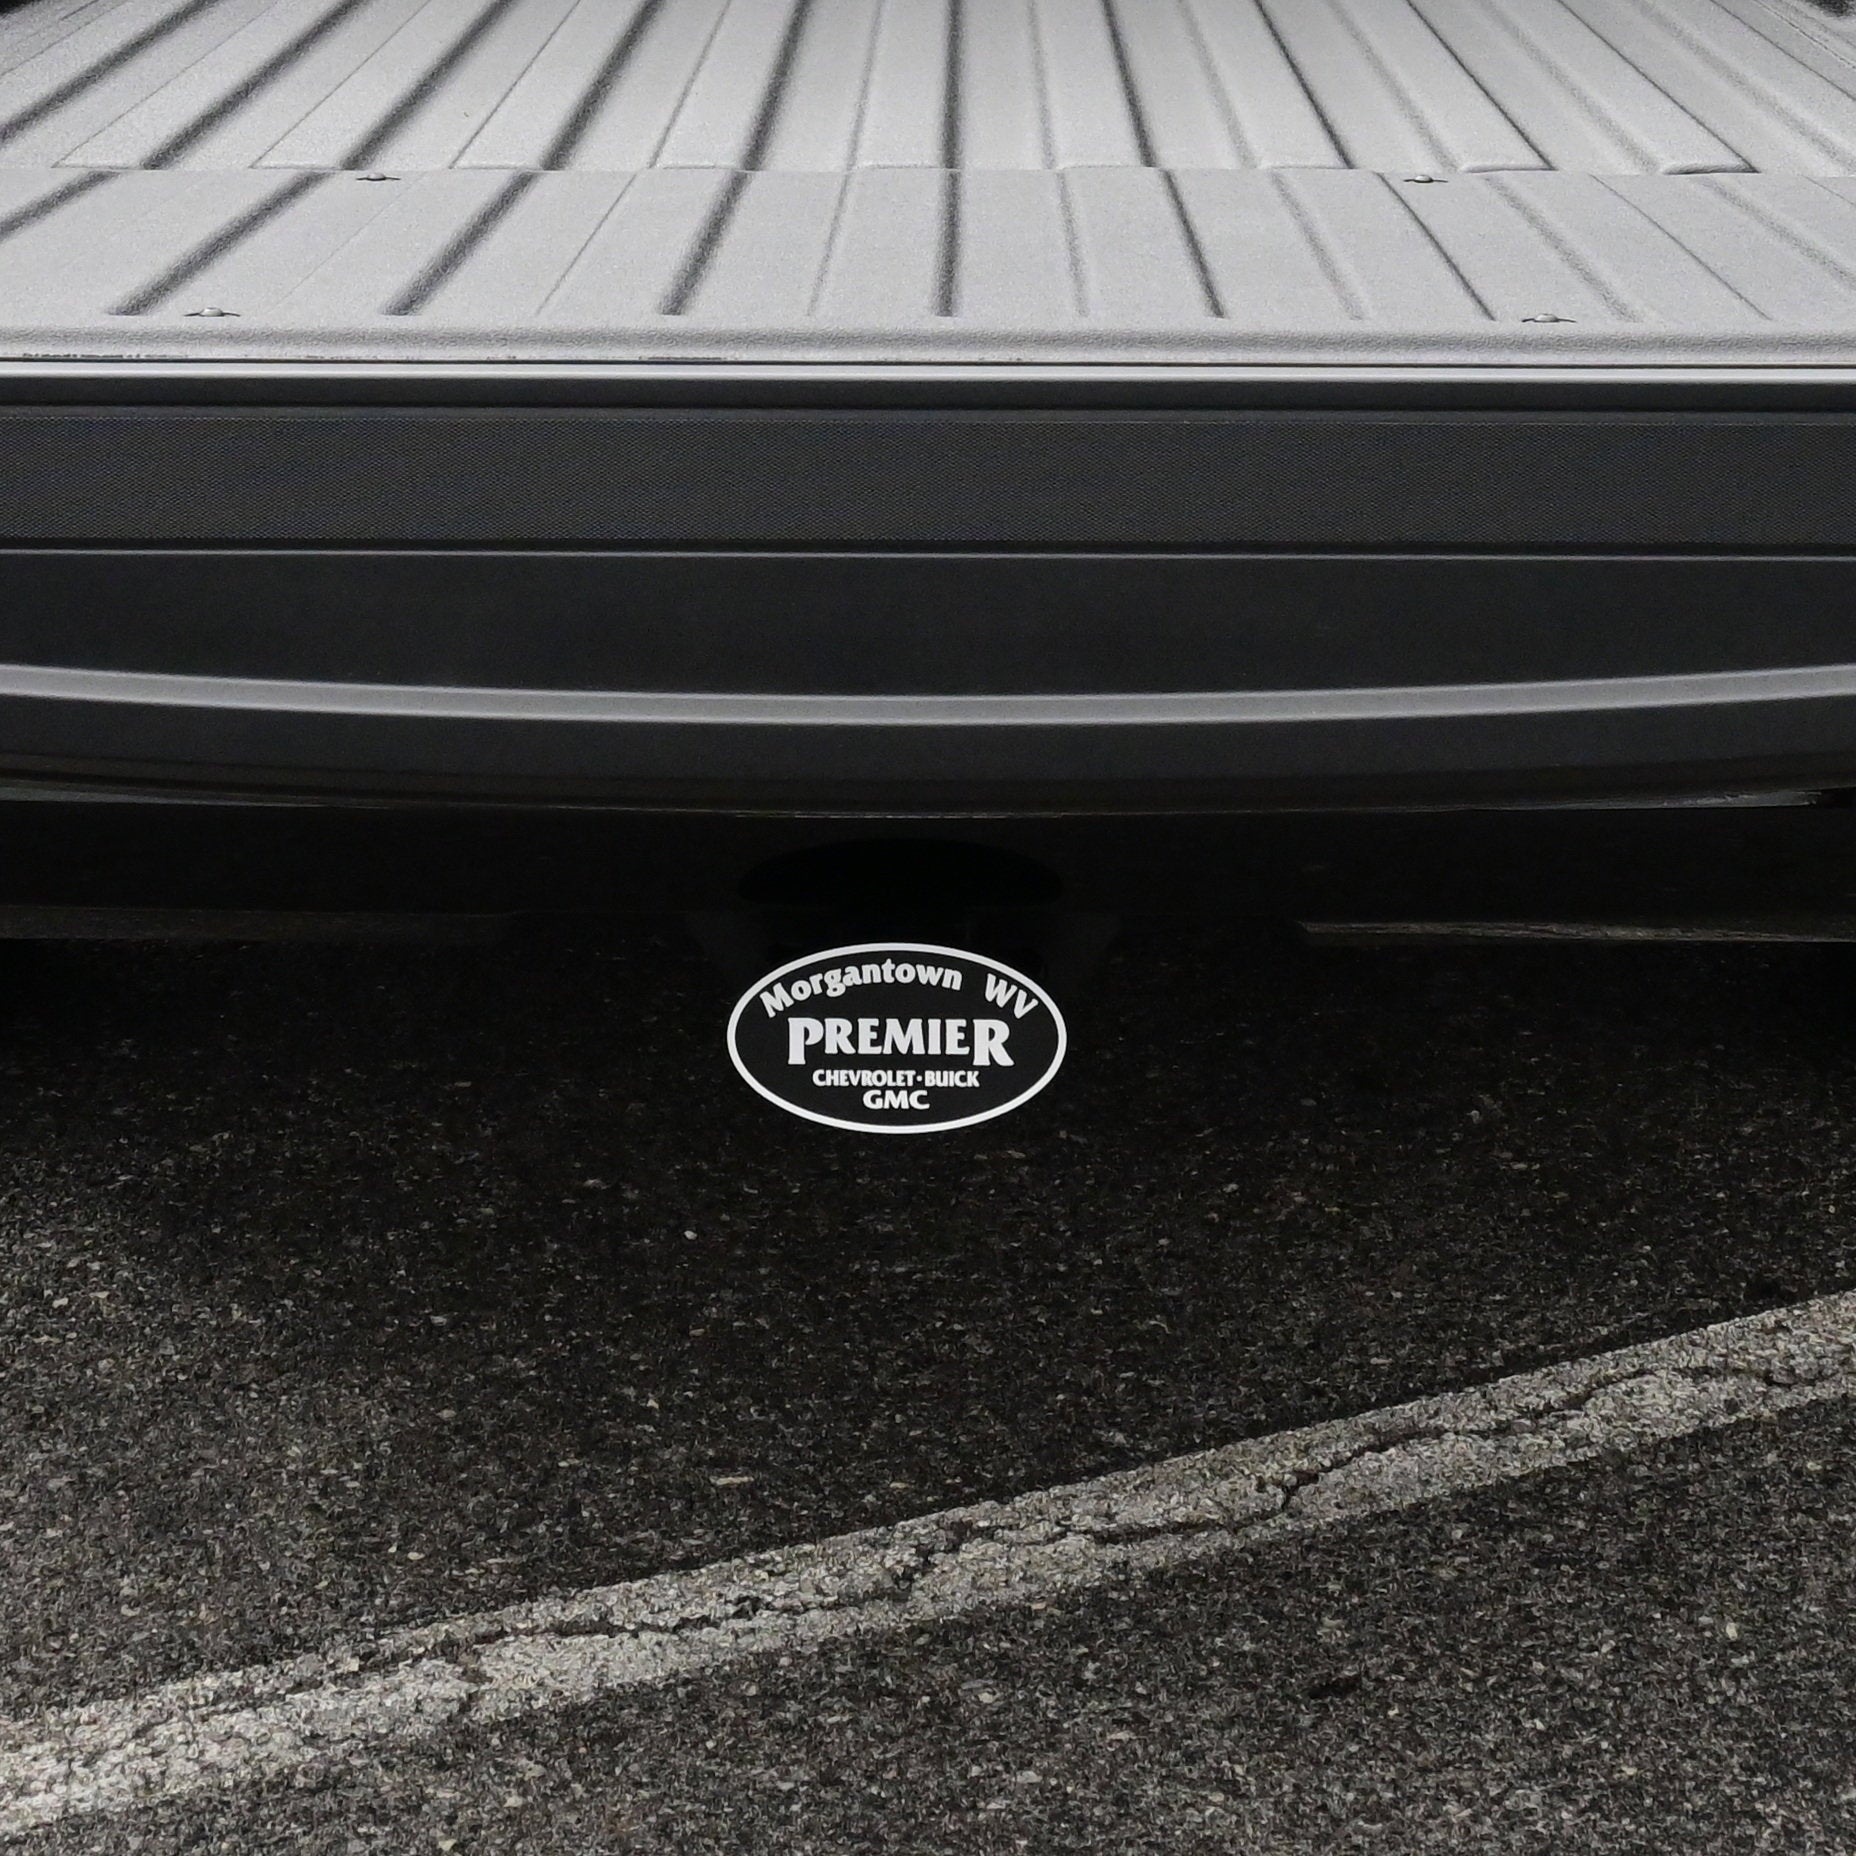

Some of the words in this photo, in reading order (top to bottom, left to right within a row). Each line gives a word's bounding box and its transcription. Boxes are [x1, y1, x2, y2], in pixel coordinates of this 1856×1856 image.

[759, 958, 962, 1018] Morgantown
[984, 973, 1039, 1019] WV
[787, 1017, 1015, 1067] PREMIER
[862, 1090, 930, 1110] GMC
